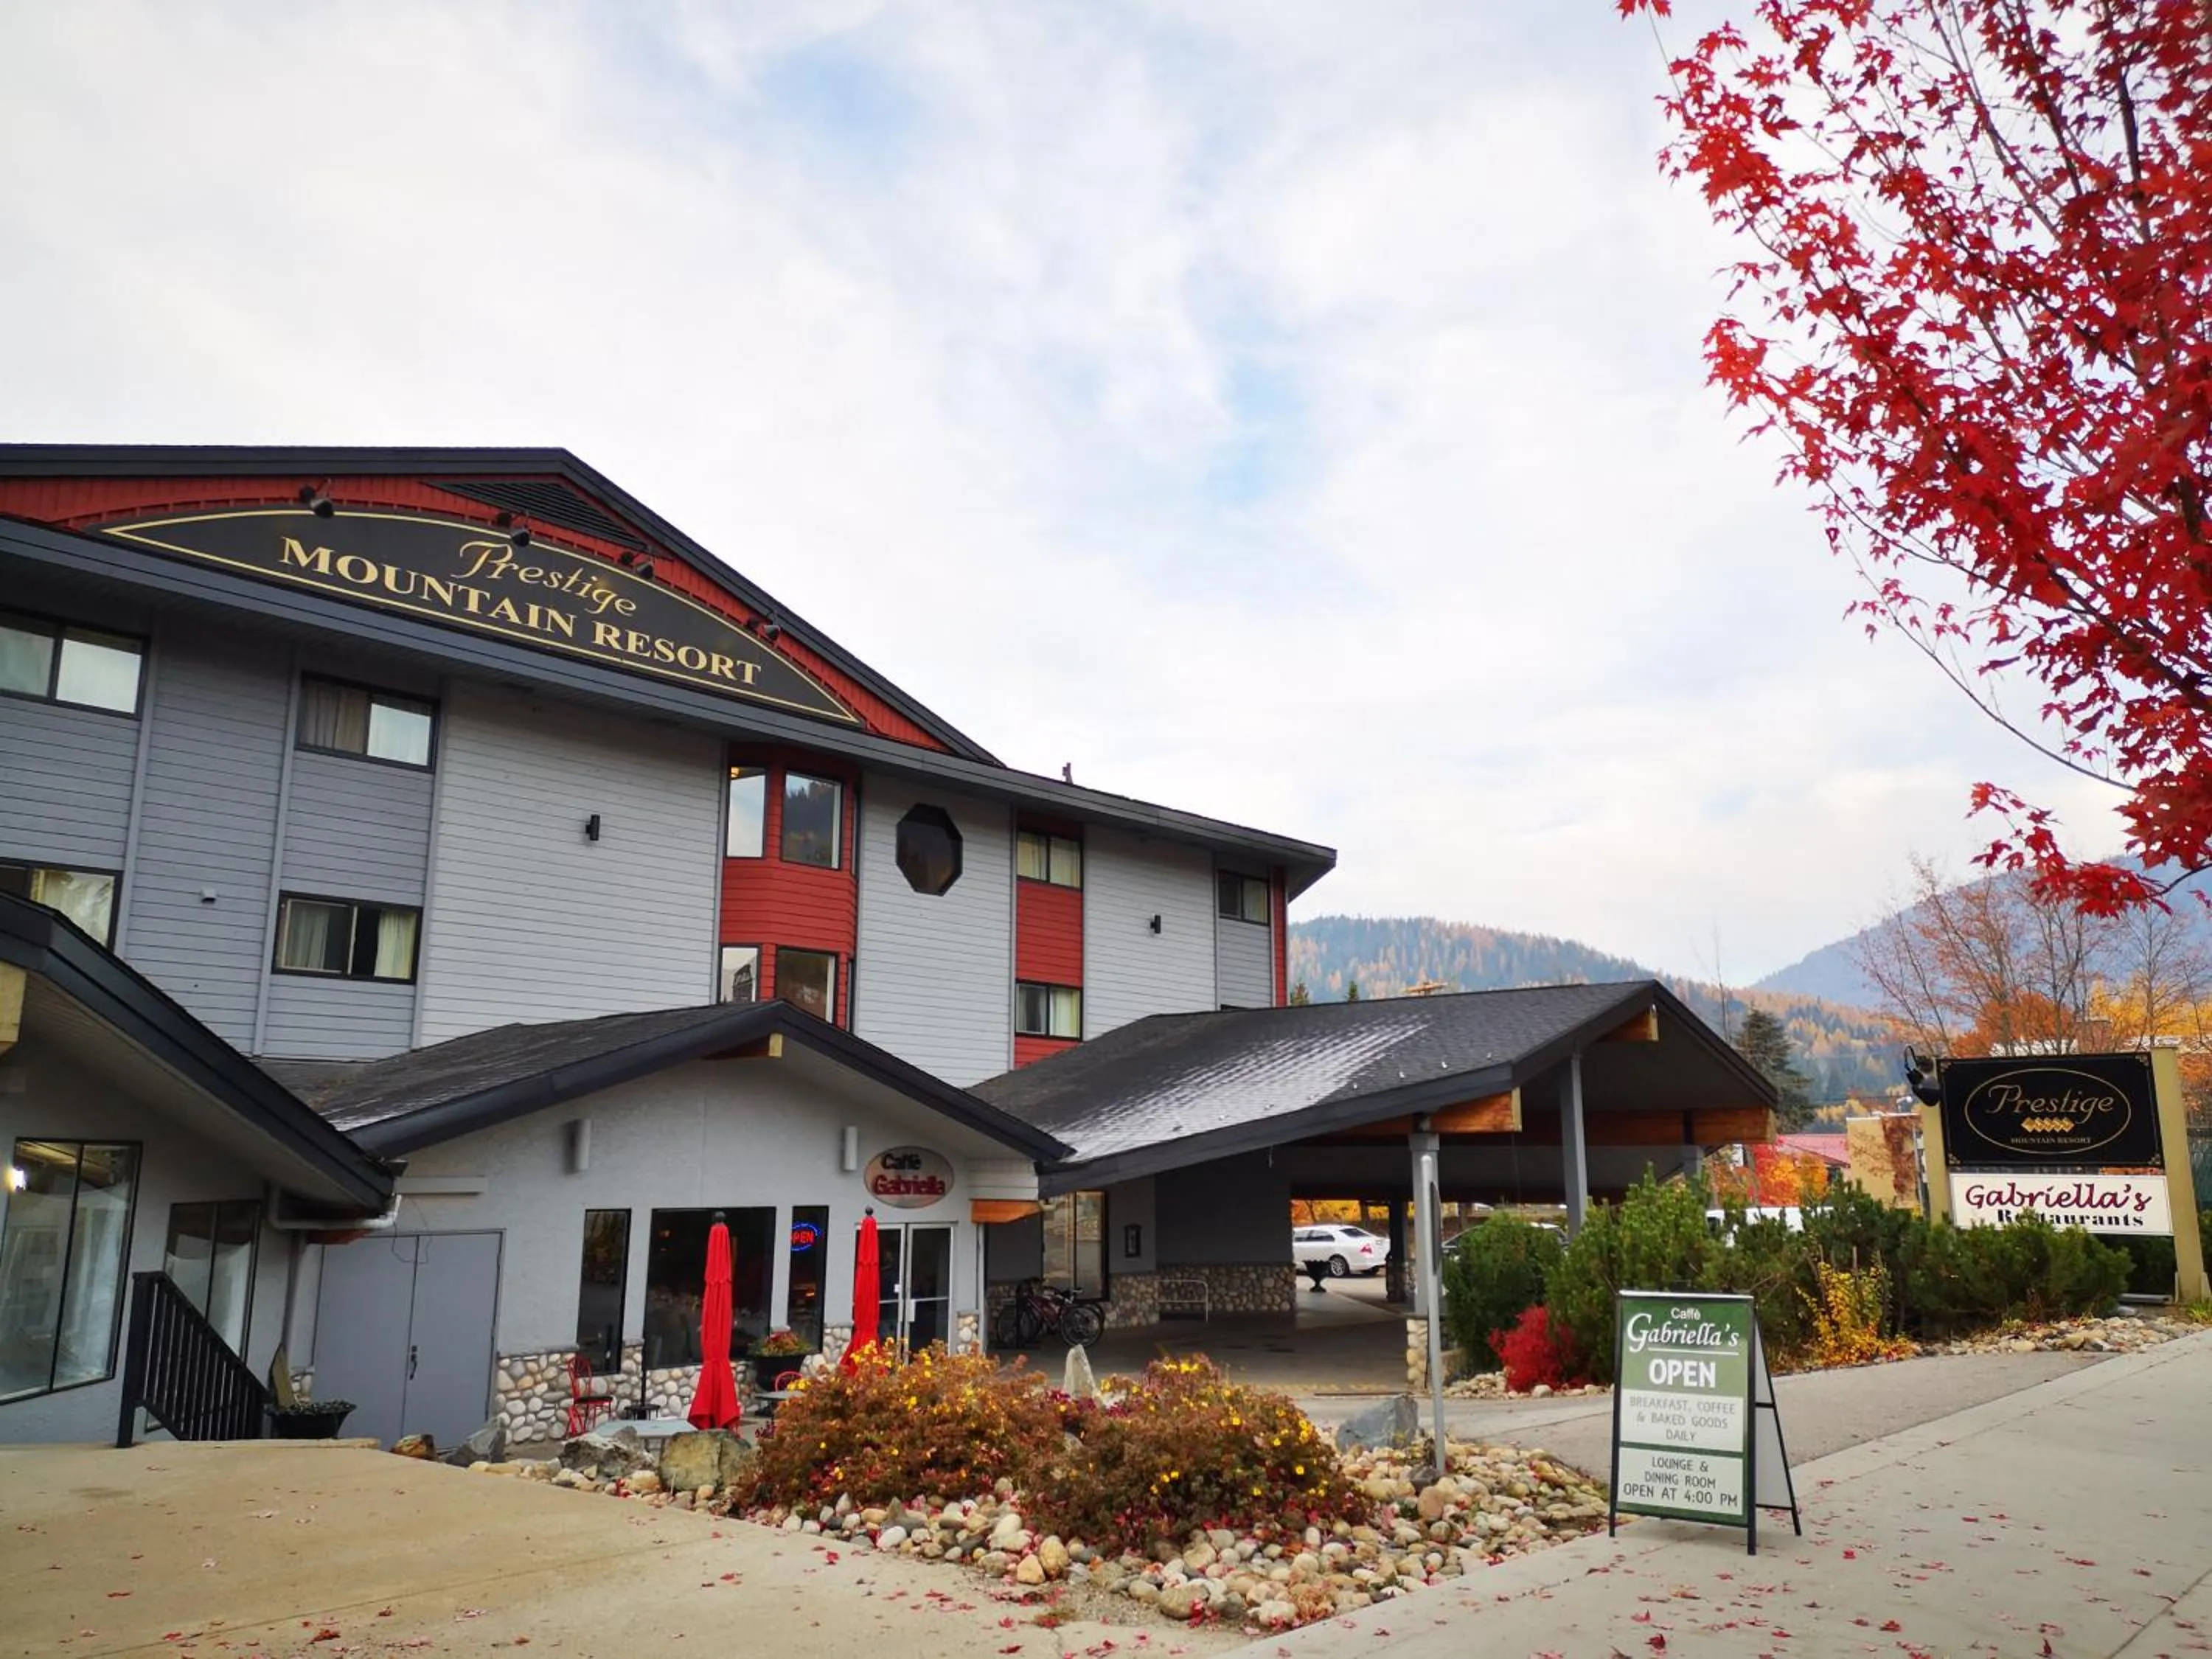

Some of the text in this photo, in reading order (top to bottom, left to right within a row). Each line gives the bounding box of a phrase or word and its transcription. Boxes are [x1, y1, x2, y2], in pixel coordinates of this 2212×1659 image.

[451, 540, 637, 617] Prestige
[279, 536, 761, 685] MOUNTAIN RESORT
[1986, 1085, 2115, 1124] Prestige
[1965, 1182, 2152, 1212] Gabriella's
[1997, 1209, 2143, 1227] Rtaurants
[790, 1230, 814, 1245] PEN
[1627, 1312, 1739, 1354] Gabriella's
[1649, 1358, 1717, 1388] OPEN
[1697, 1401, 1735, 1415] COFFEE
[1636, 1411, 1728, 1429] & BAKED GOODS
[1666, 1428, 1697, 1441] DAILY
[1652, 1456, 1709, 1472] LOUNGE &
[1644, 1471, 1717, 1489] DINING ROOM
[1623, 1482, 1739, 1507] OPEN AT 4:00 PM
